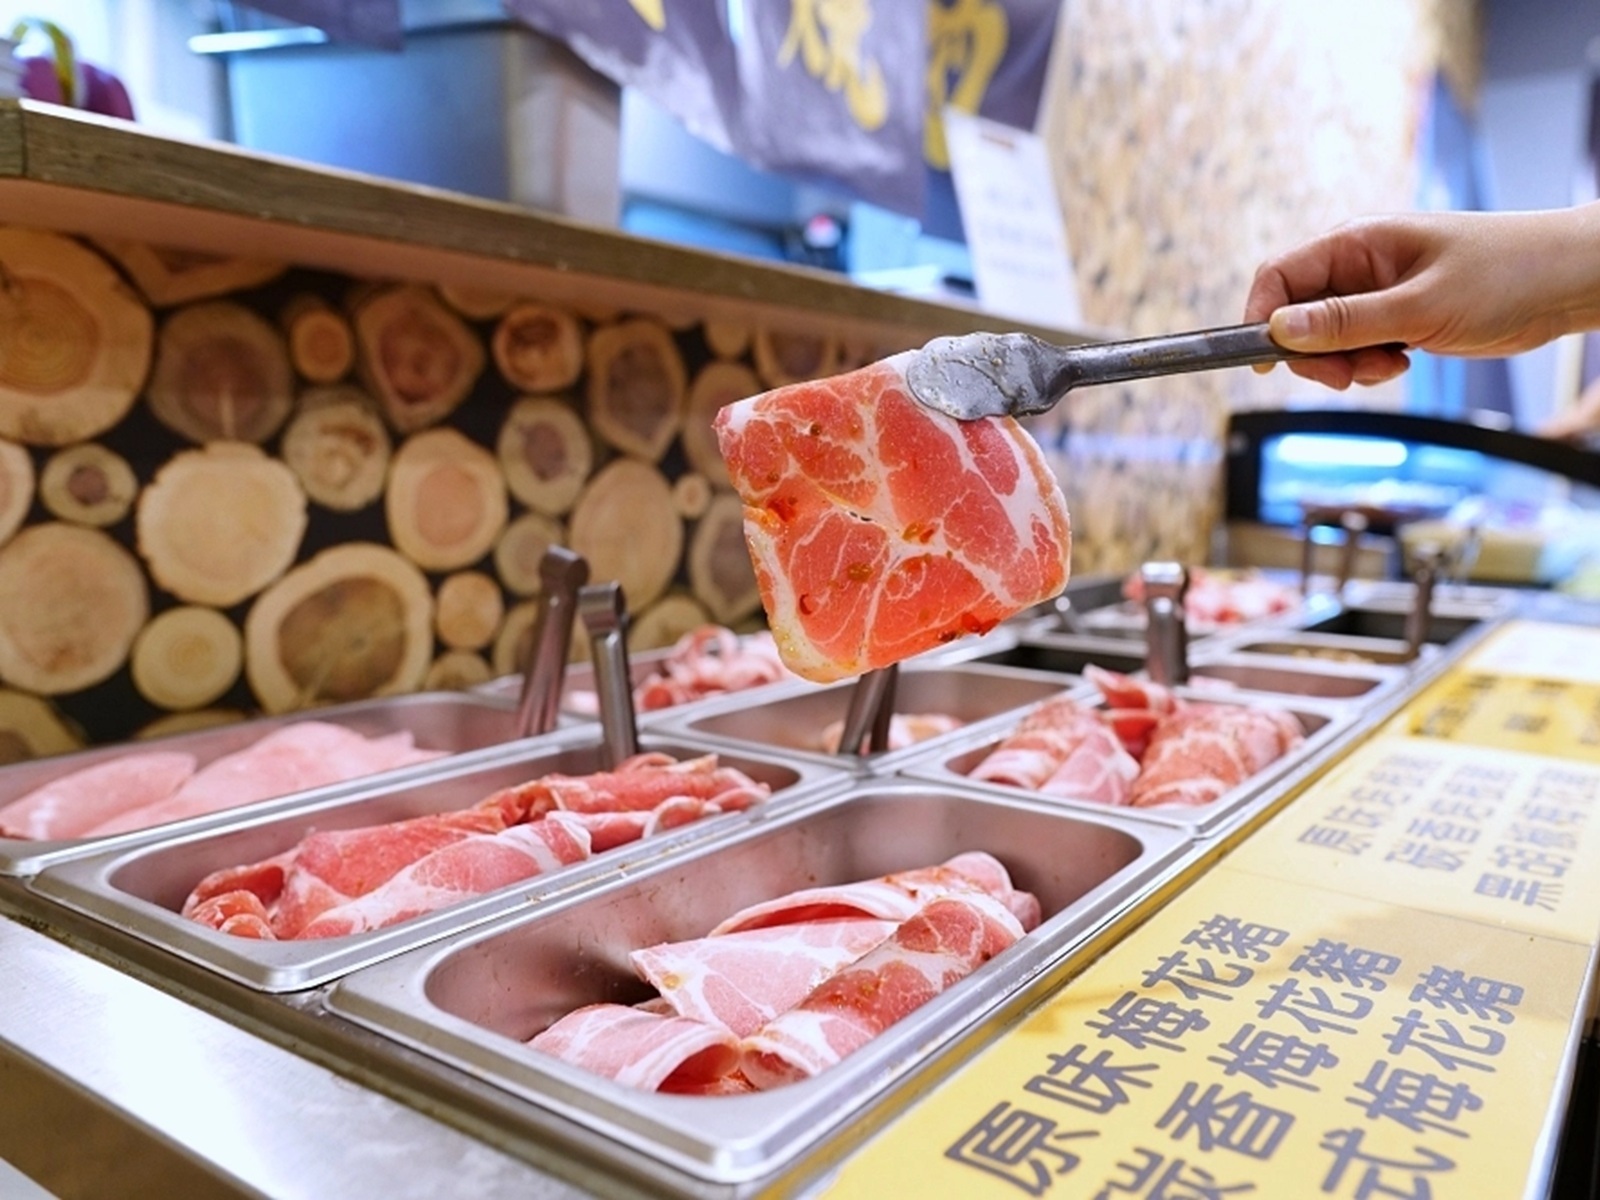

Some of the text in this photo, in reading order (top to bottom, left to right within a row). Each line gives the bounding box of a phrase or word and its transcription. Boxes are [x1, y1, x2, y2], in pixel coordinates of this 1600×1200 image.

[943, 912, 1291, 1198] 原味梅花豬
